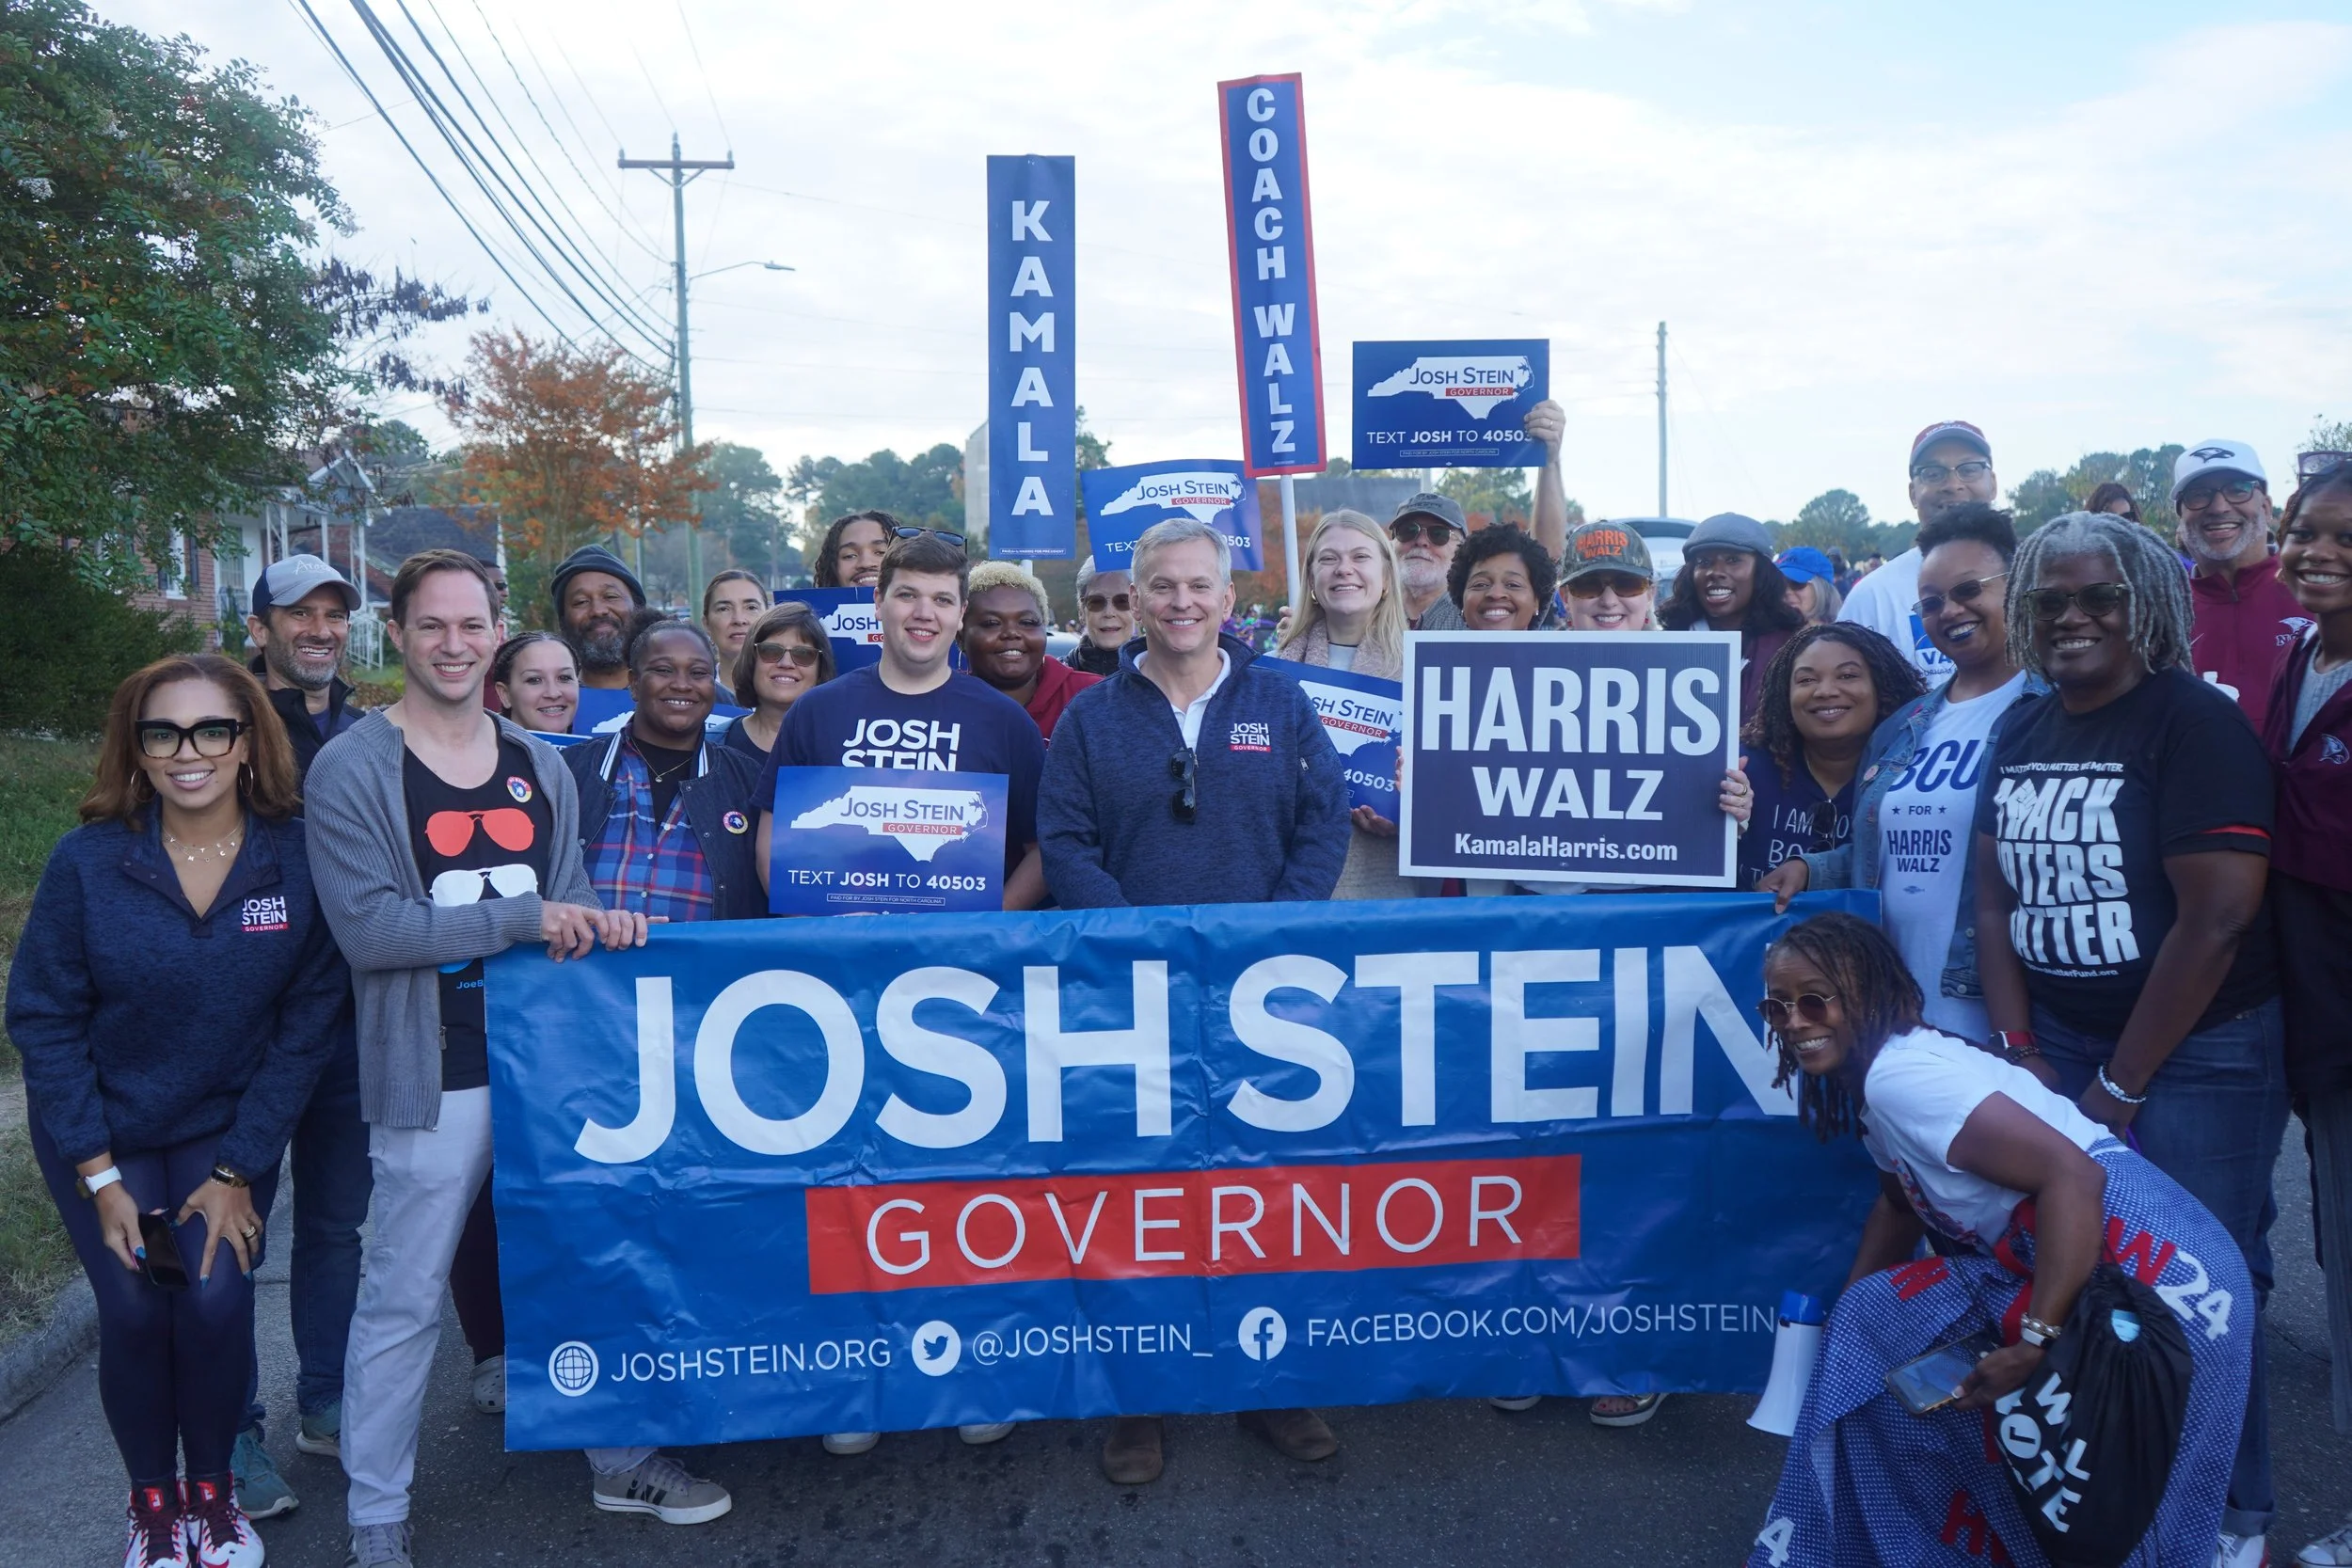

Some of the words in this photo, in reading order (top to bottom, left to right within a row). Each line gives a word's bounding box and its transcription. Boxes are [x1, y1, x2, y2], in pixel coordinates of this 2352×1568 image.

[1247, 87, 1286, 281] COACH
[1009, 200, 1055, 516] KAMALA
[1253, 302, 1295, 453] WALZ
[1409, 367, 1457, 385] JOSH
[1463, 366, 1514, 384] STEIN
[1450, 388, 1509, 396] GOVERNOR
[1367, 432, 1406, 444] TEXT
[1410, 431, 1452, 443] JOSH
[1457, 430, 1478, 442] TO
[1136, 484, 1181, 499] JOSH
[1184, 480, 1230, 496] STEIN
[1222, 534, 1251, 547] 503
[1576, 530, 1629, 552] HARRIS
[1584, 546, 1623, 559] WALZ
[832, 614, 879, 631] JOSH
[1311, 696, 1335, 713] SH
[1338, 699, 1393, 727] STEIN
[1422, 666, 1722, 756] HARRIS
[842, 719, 961, 752] JOSH
[1230, 722, 1269, 734] JOSH
[1321, 716, 1382, 737] GOVERNOR
[1230, 734, 1270, 746] STEIN
[1886, 739, 1980, 793] BCU
[1343, 768, 1394, 793] 40503
[1471, 766, 1664, 821] WALZ
[840, 798, 898, 818] JOSH
[903, 800, 963, 821] STEIN
[1785, 808, 1815, 836] AM
[1908, 805, 1931, 816] FOR
[888, 824, 957, 834] GOVERNOR
[1454, 832, 1677, 862] KamalaHarris.com
[1886, 829, 1952, 856] HARRIS
[1897, 857, 1940, 873] WALZ
[1995, 840, 2130, 906] OTERS
[788, 869, 835, 885] TEXT
[839, 872, 889, 887] JOSH
[896, 874, 921, 888] TO
[927, 875, 986, 891] 40503
[242, 896, 285, 911] JOSH
[242, 910, 287, 925] STEIN
[2010, 900, 2141, 965] ATTER
[573, 959, 1172, 1164] JOSH
[1226, 944, 1799, 1132] STEIN
[866, 1175, 1523, 1275] GOVERNOR
[1308, 1302, 1775, 1348] FACEBOOK.COM/JOSHSTEIN
[972, 1322, 1214, 1367] @JOSHSTEIN_
[610, 1336, 892, 1384] JOSHSTEIN.ORG
